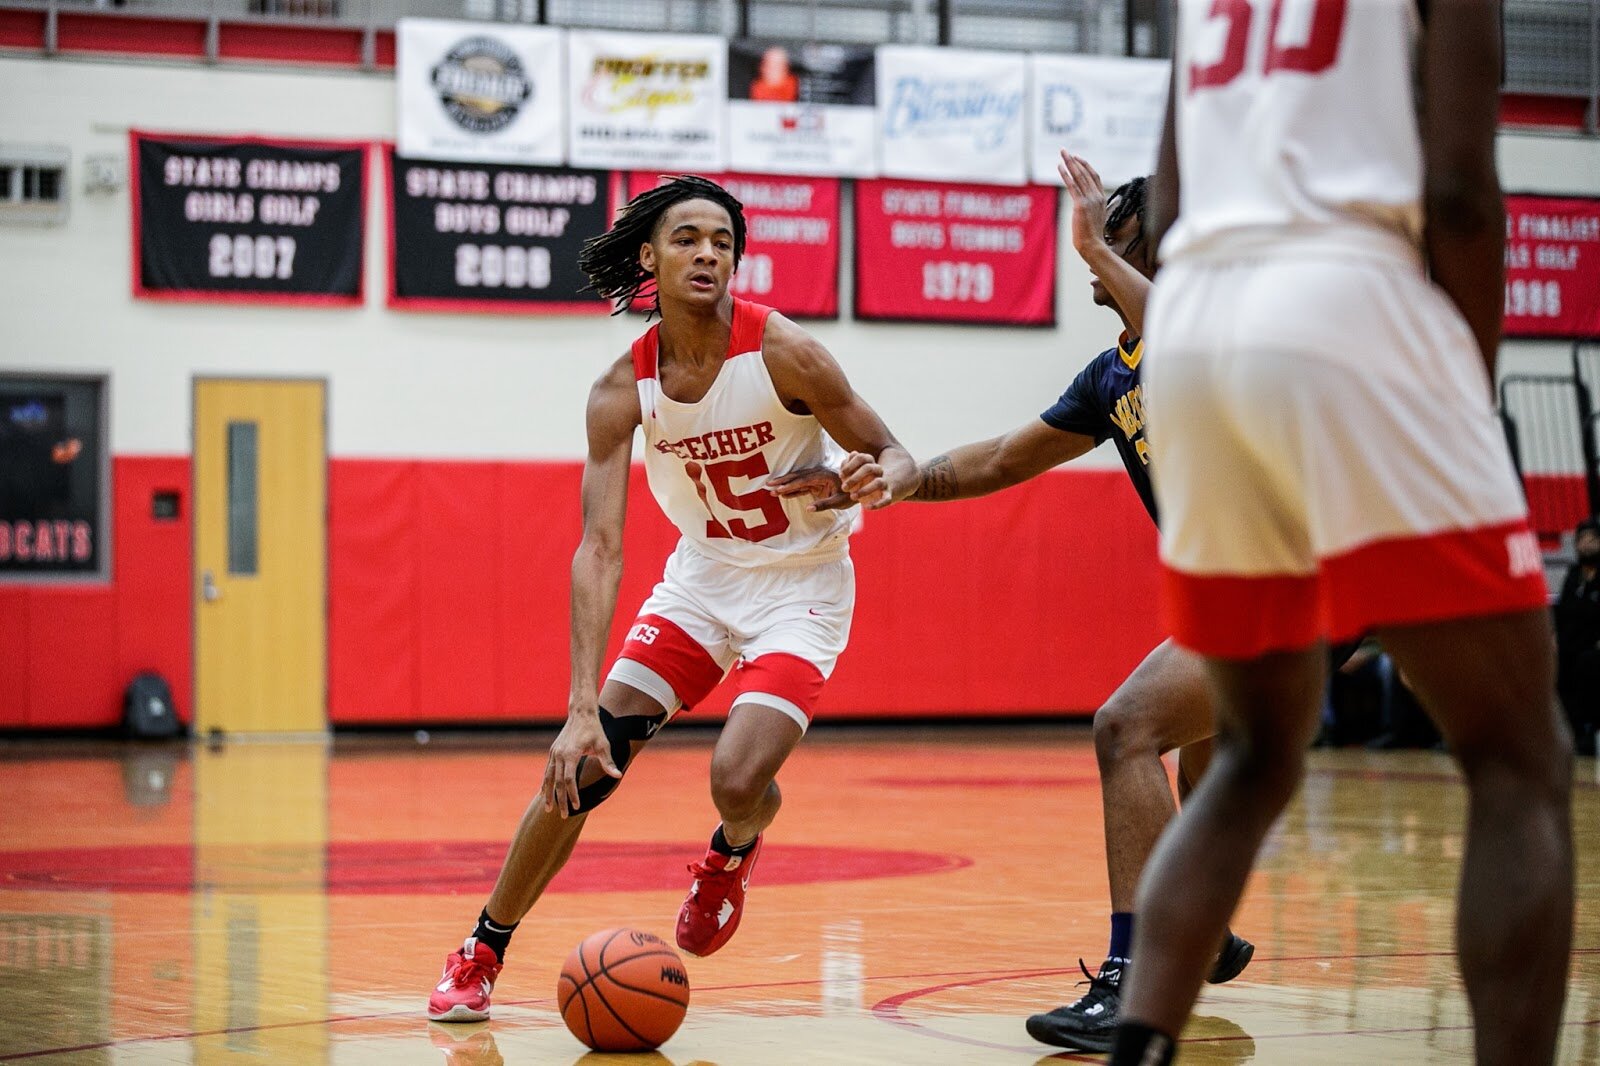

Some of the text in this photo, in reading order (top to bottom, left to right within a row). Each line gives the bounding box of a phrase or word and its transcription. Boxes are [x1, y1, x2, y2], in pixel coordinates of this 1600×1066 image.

[165, 156, 340, 192] STATE CHAMPS
[406, 168, 596, 204] STATE CHAMPS
[185, 192, 320, 226] GIRLS GOLF
[435, 203, 570, 237] BOYS GOLF
[882, 188, 1031, 221] STATE FINALIST
[208, 234, 296, 279] 2007
[456, 243, 550, 289] 2008
[923, 261, 993, 302] 1979
[685, 451, 790, 543] 15
